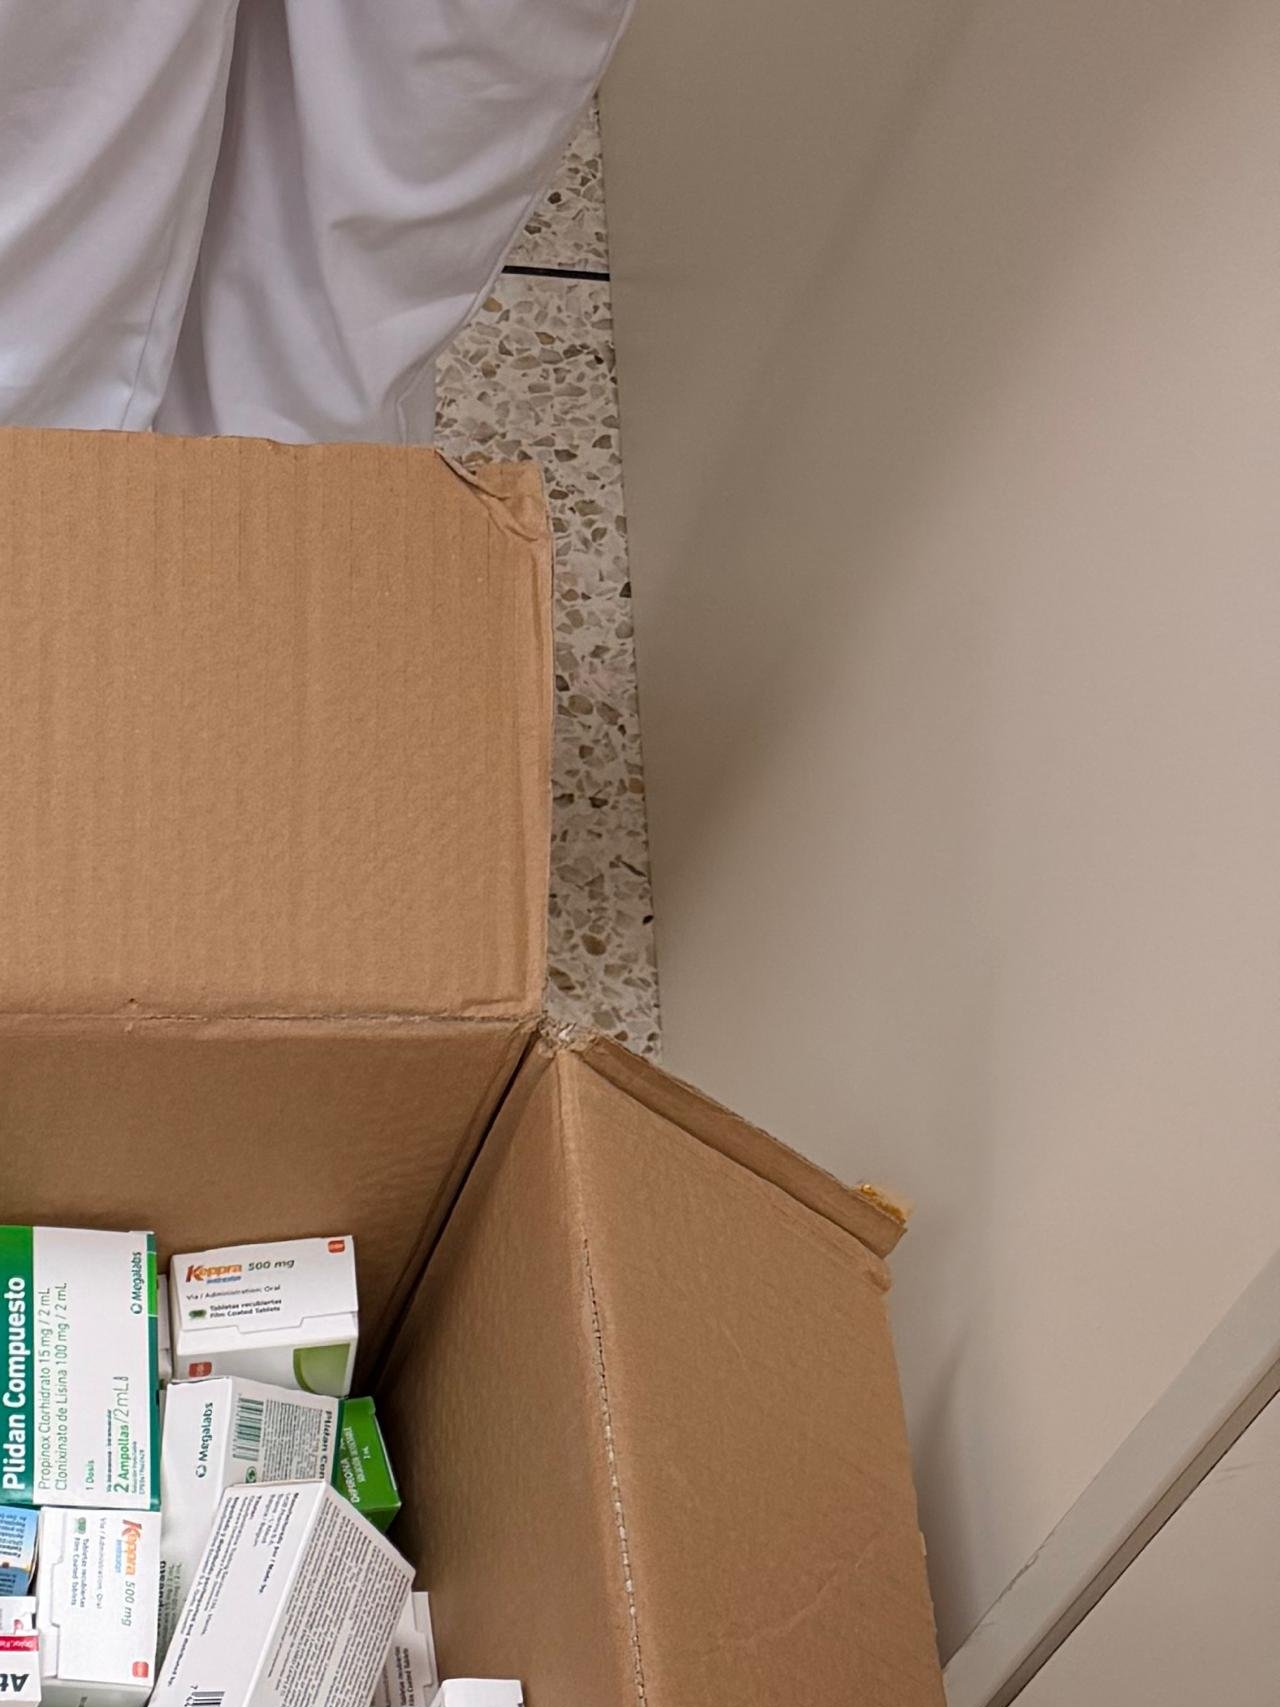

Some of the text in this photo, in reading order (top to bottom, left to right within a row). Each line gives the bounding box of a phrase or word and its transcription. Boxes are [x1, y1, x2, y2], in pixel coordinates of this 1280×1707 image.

[130, 1251, 143, 1301] Megalabs
[248, 1261, 271, 1272] 500
[2, 1277, 31, 1490] Plidan Compuesto
[113, 1481, 131, 1493] 2
